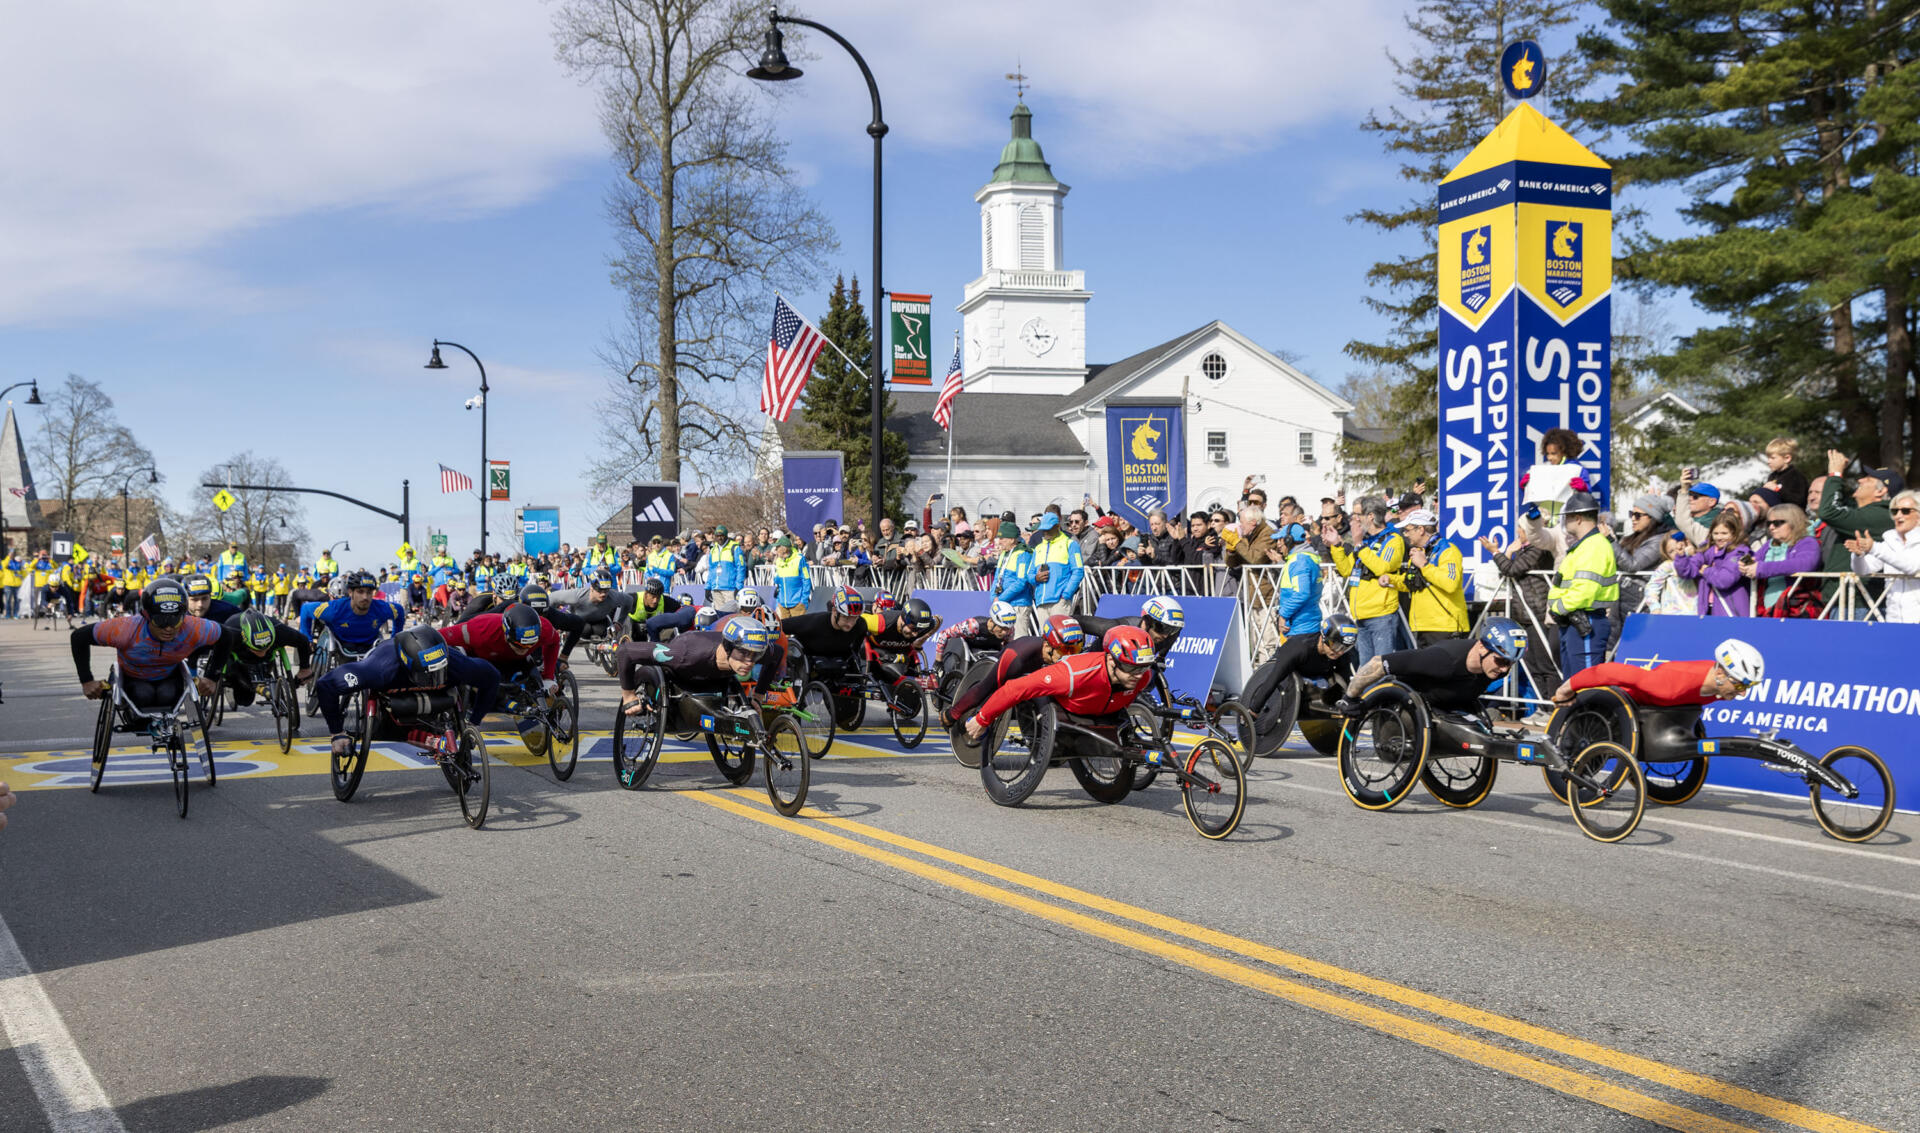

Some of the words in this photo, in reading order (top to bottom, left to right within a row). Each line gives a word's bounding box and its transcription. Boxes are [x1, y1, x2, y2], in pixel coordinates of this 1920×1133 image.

[1519, 180, 1541, 190] BANK
[1542, 182, 1553, 190] OF
[1554, 184, 1590, 194] AMERICA
[1440, 200, 1458, 211] BANK
[1468, 187, 1497, 202] AMERICA
[1461, 264, 1490, 280] BOSTON
[1546, 259, 1582, 271] BOSTON
[1461, 274, 1490, 287] MARATHON
[1546, 270, 1582, 278] MARATHON
[891, 301, 930, 315] HOPKINTON
[1487, 340, 1508, 553] HOPKINTO
[1125, 463, 1167, 475] BOSTON
[1125, 475, 1167, 484] MARATHON
[1717, 708, 1740, 724] OF
[1742, 711, 1829, 733] AMERICA
[1776, 748, 1808, 768] TOYOTA
